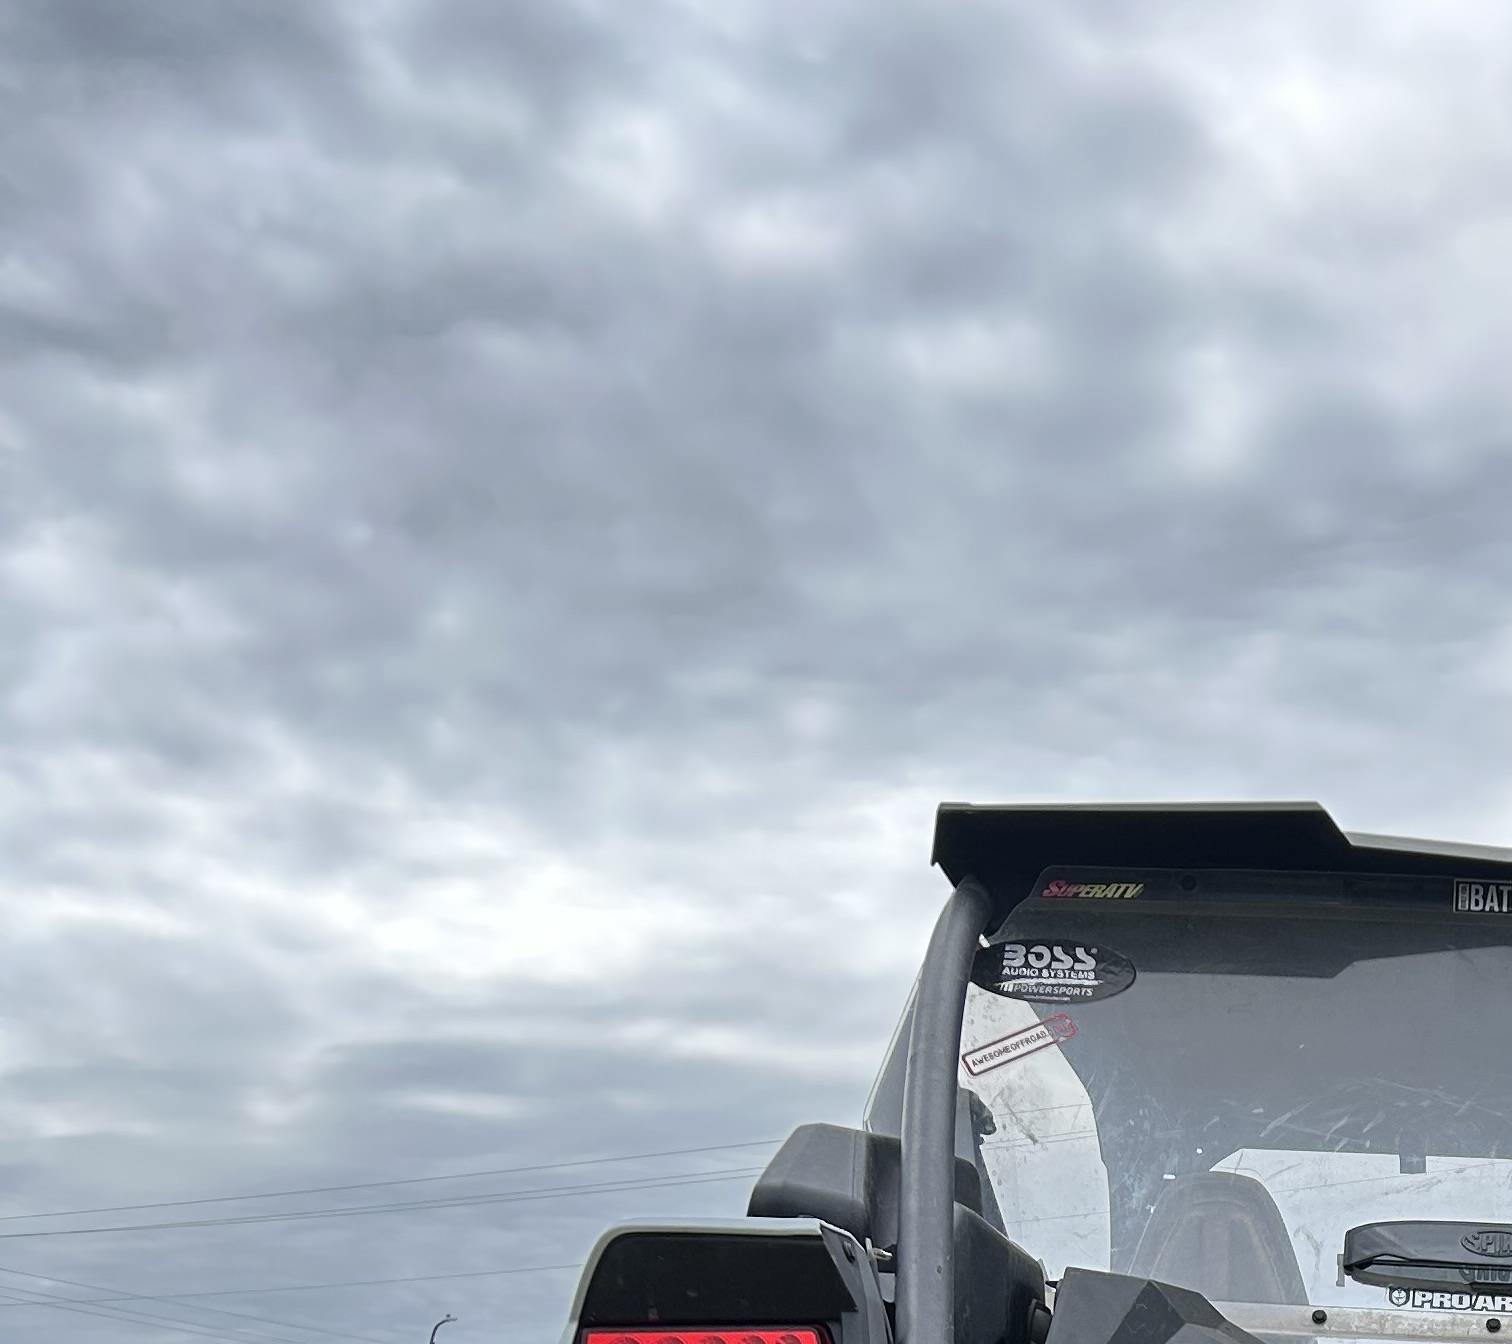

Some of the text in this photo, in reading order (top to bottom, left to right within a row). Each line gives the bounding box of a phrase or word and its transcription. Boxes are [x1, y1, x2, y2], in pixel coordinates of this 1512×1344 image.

[1041, 880, 1145, 899] SUPERATV
[1002, 944, 1097, 970] BOSS
[1002, 966, 1096, 980] AUDIO SYSTEMS
[1012, 983, 1094, 997] POWERSPORTS
